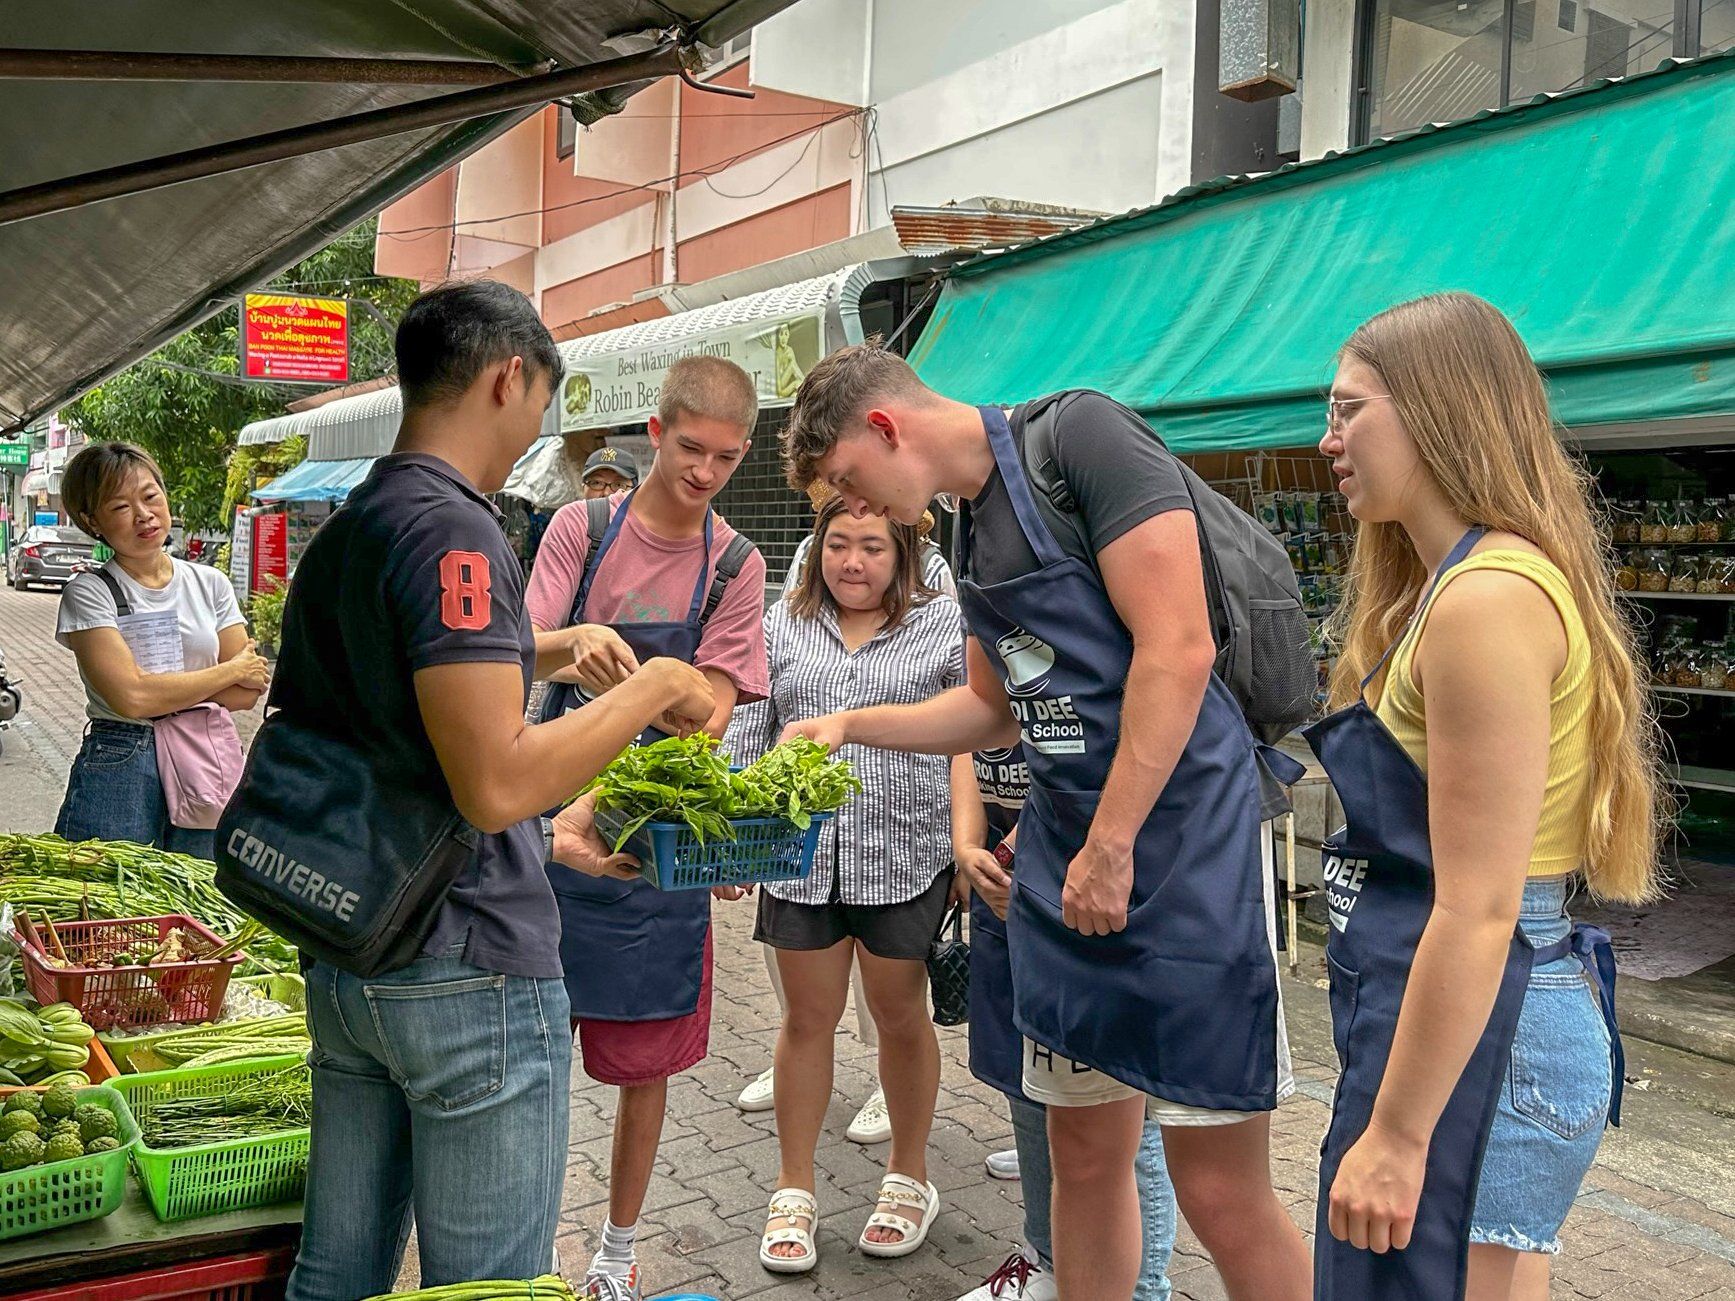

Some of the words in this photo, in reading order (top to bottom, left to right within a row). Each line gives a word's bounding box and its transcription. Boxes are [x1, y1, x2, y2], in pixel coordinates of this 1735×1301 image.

[261, 327, 331, 346] นวดเพื่อสุขภาพ
[276, 344, 288, 352] THAI
[326, 347, 346, 355] HEALTH
[617, 356, 638, 377] Best
[698, 339, 731, 358] Town
[594, 384, 633, 414] Robin
[637, 381, 661, 408] Bea
[439, 550, 491, 630] 8
[1033, 695, 1079, 721] DEE
[1032, 722, 1084, 738] School
[974, 761, 994, 782] ROI
[998, 762, 1031, 784] DEE
[227, 828, 361, 922] CONVERSE
[1325, 887, 1357, 913] chool
